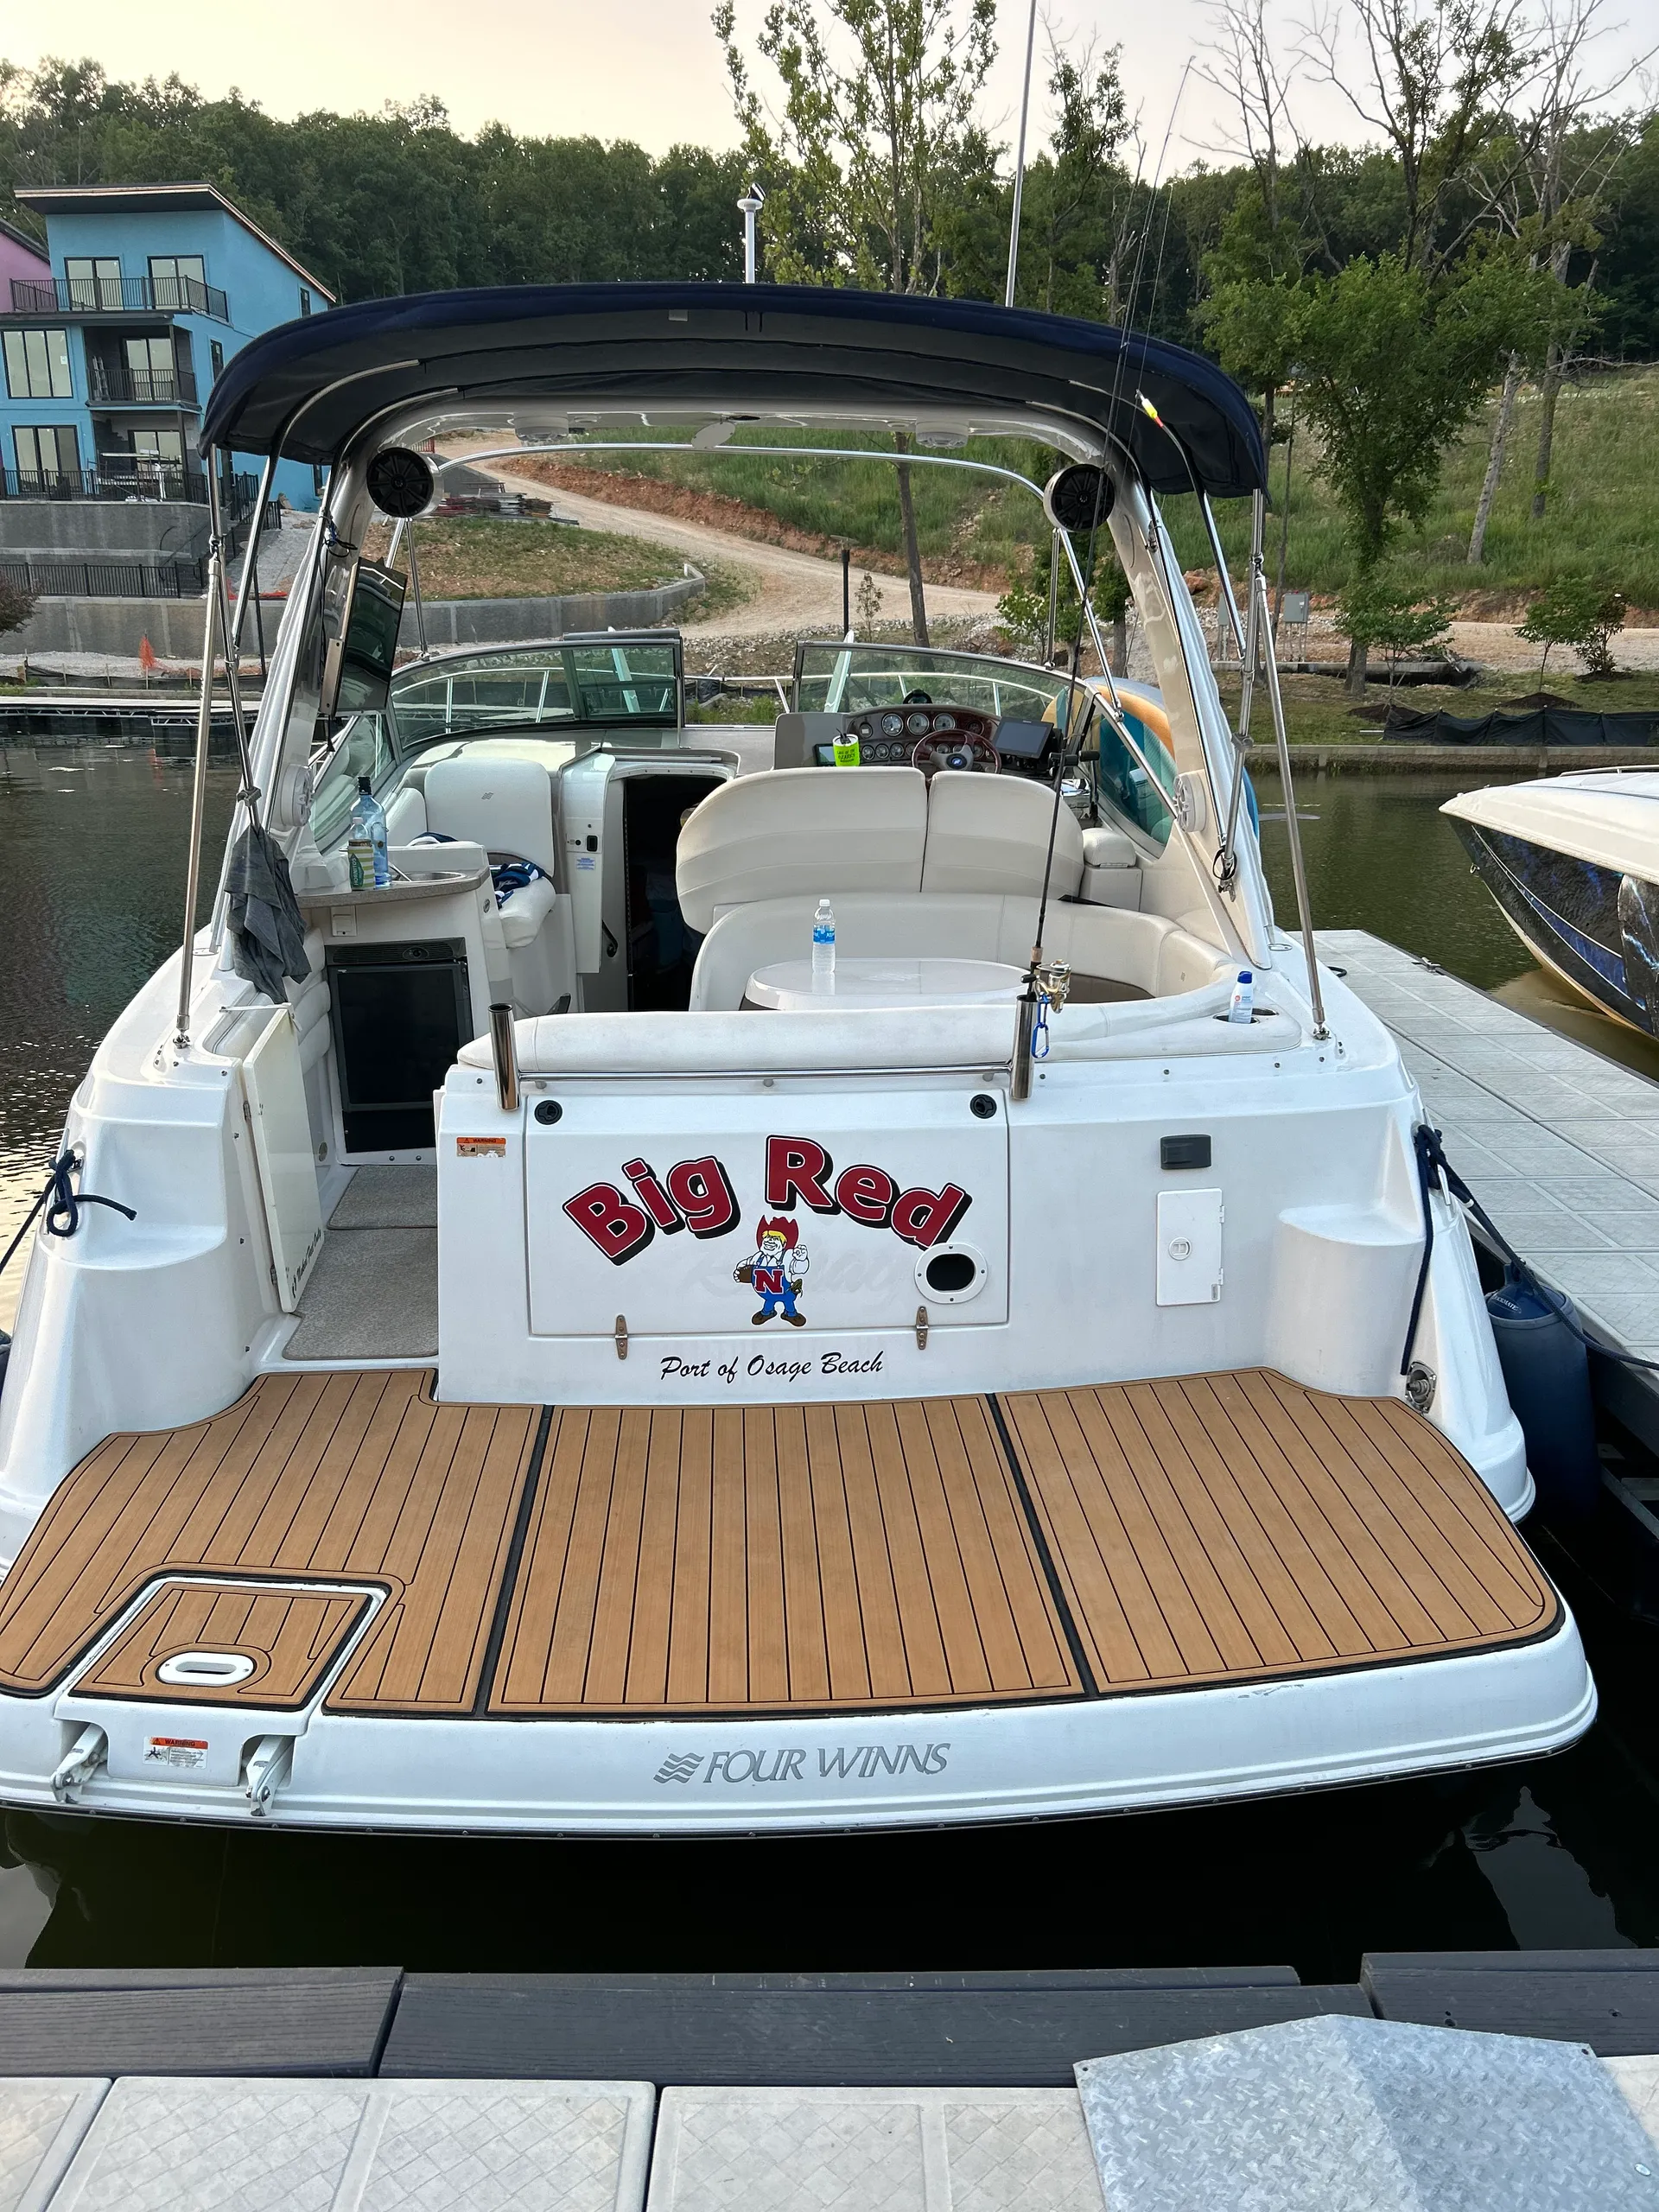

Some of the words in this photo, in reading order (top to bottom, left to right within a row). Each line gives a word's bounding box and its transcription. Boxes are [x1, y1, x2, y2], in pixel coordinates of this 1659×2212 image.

[563, 1155, 741, 1266] Big
[766, 1135, 972, 1250] Red
[753, 1268, 784, 1294] N
[660, 1356, 711, 1380] Port
[717, 1356, 739, 1384] of
[747, 1354, 811, 1382] Osage
[820, 1351, 884, 1374] Beach
[702, 1749, 806, 1783] FOUR
[817, 1743, 951, 1779] WINNS
